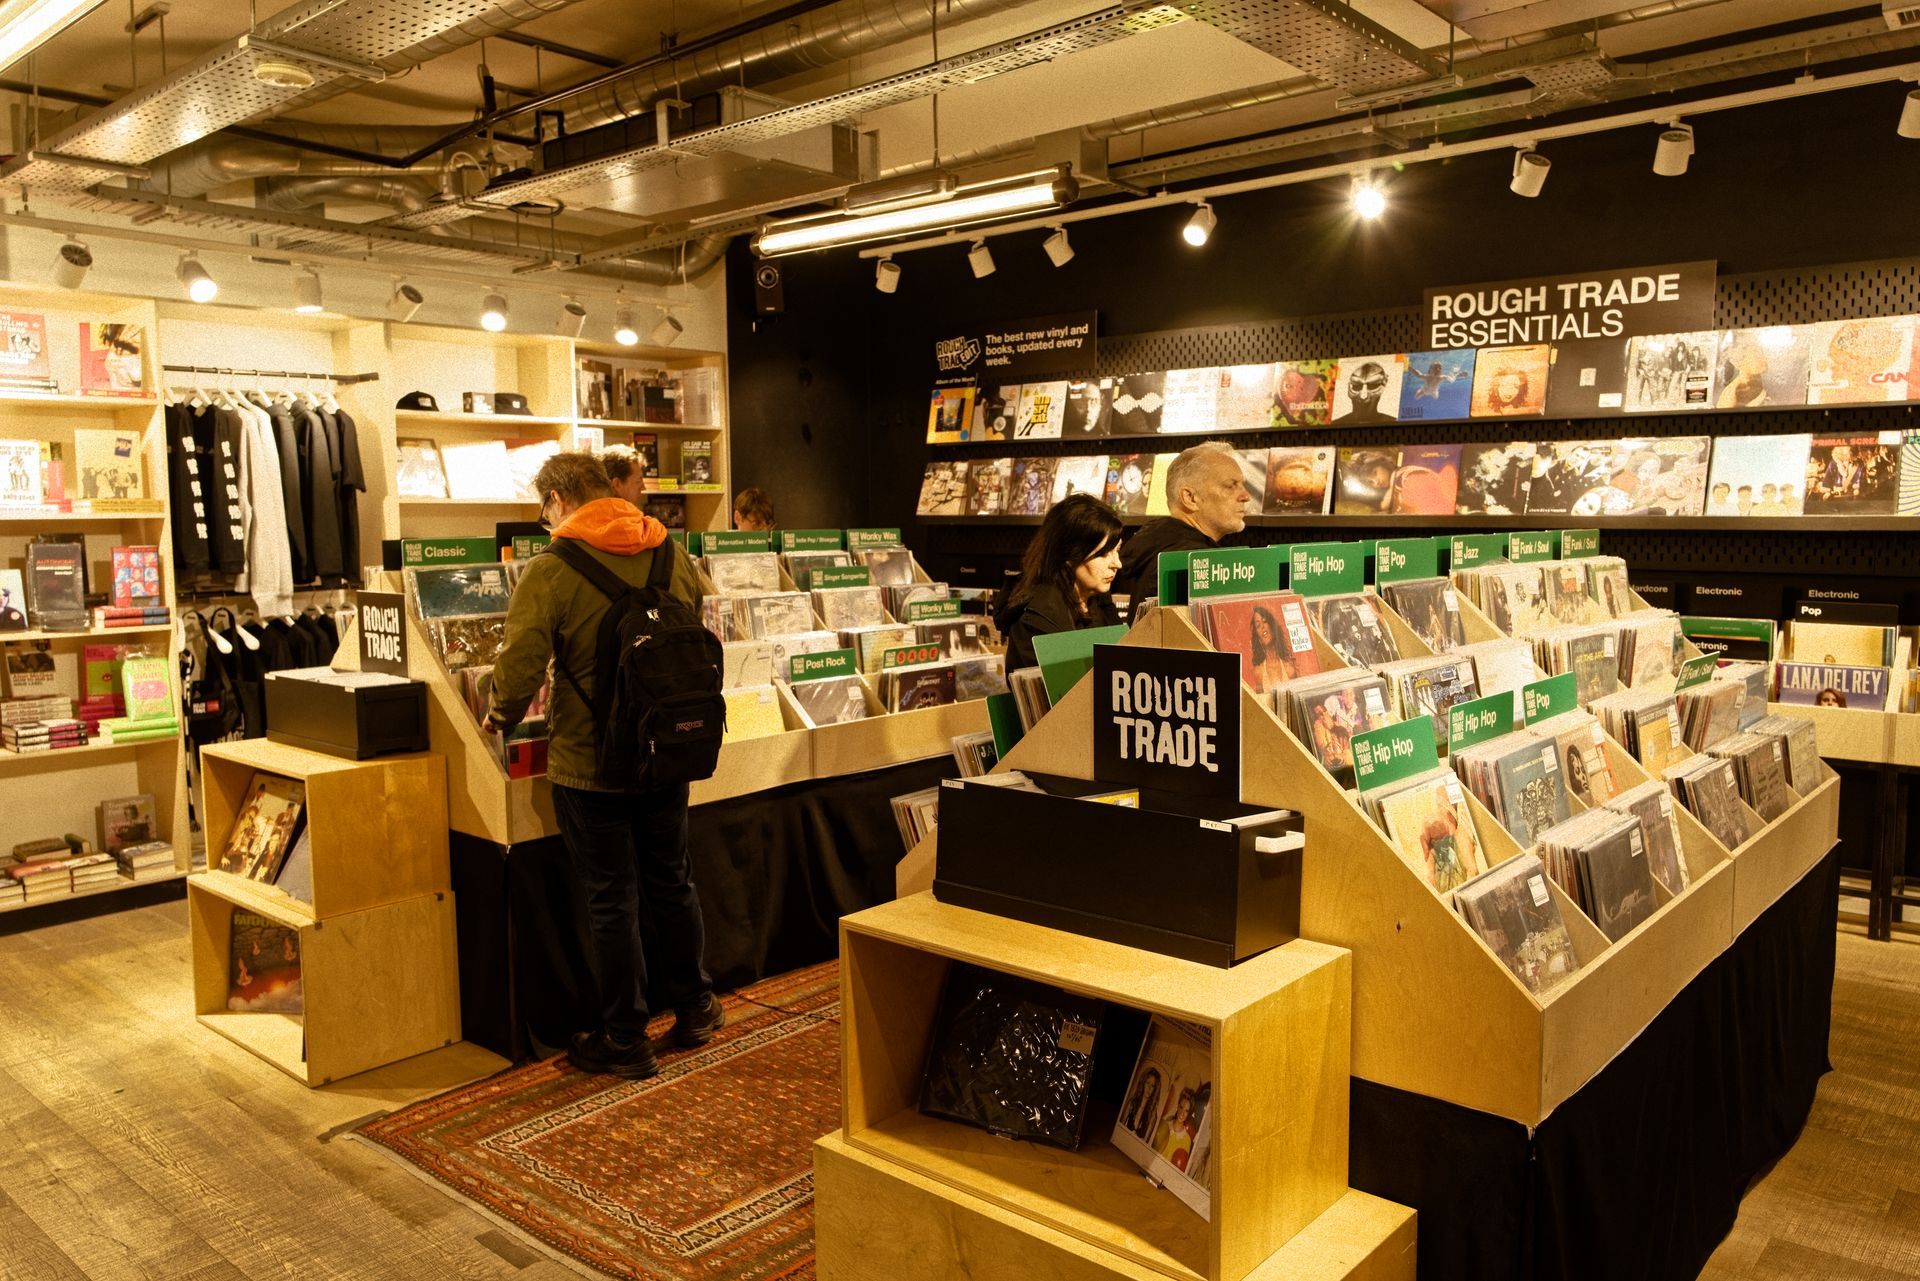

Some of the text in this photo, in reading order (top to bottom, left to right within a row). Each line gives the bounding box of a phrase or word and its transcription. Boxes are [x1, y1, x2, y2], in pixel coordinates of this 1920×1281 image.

[1432, 273, 1681, 320] ROUGH TRADE
[985, 323, 1088, 344] The best new vinyl and
[1431, 309, 1624, 348] ESSENTIALS
[937, 336, 966, 355] ROUGH
[985, 337, 1083, 355] books, updated every
[961, 345, 976, 363] EDIT
[985, 356, 1011, 366] week.
[1812, 438, 1847, 446] PRIMAL
[718, 538, 744, 546] Alternative
[859, 531, 882, 542] Wonky
[882, 531, 897, 540] Wax
[1571, 539, 1583, 551] Funk
[1586, 537, 1597, 549] Soul
[424, 546, 466, 558] Classic
[1464, 546, 1479, 560] Jazz
[1520, 541, 1533, 555] Funk
[1537, 540, 1550, 553] Soul
[1309, 555, 1345, 576] Hip Hop
[1391, 552, 1405, 569] Pop
[1212, 562, 1255, 584] Hip Hop
[1632, 584, 1669, 592] ardcore
[1696, 586, 1743, 596] Electronic
[1808, 589, 1860, 599] Electronic
[920, 604, 943, 613] Wonky
[943, 602, 957, 611] Wax
[1800, 605, 1822, 616] Pop
[363, 605, 399, 634] ROUGH
[365, 633, 402, 663] TRADE
[1694, 641, 1729, 651] ctronic
[806, 656, 846, 670] Post Rock
[898, 648, 937, 662] SALE
[1687, 666, 1700, 680] Funk
[1782, 665, 1883, 695] LANA DEL REY
[1112, 670, 1217, 723] ROUGH
[1536, 693, 1550, 710] Pop
[1465, 709, 1496, 733] Hip Hop
[1113, 716, 1218, 773] TRADE
[1372, 737, 1413, 765] Hip Hop
